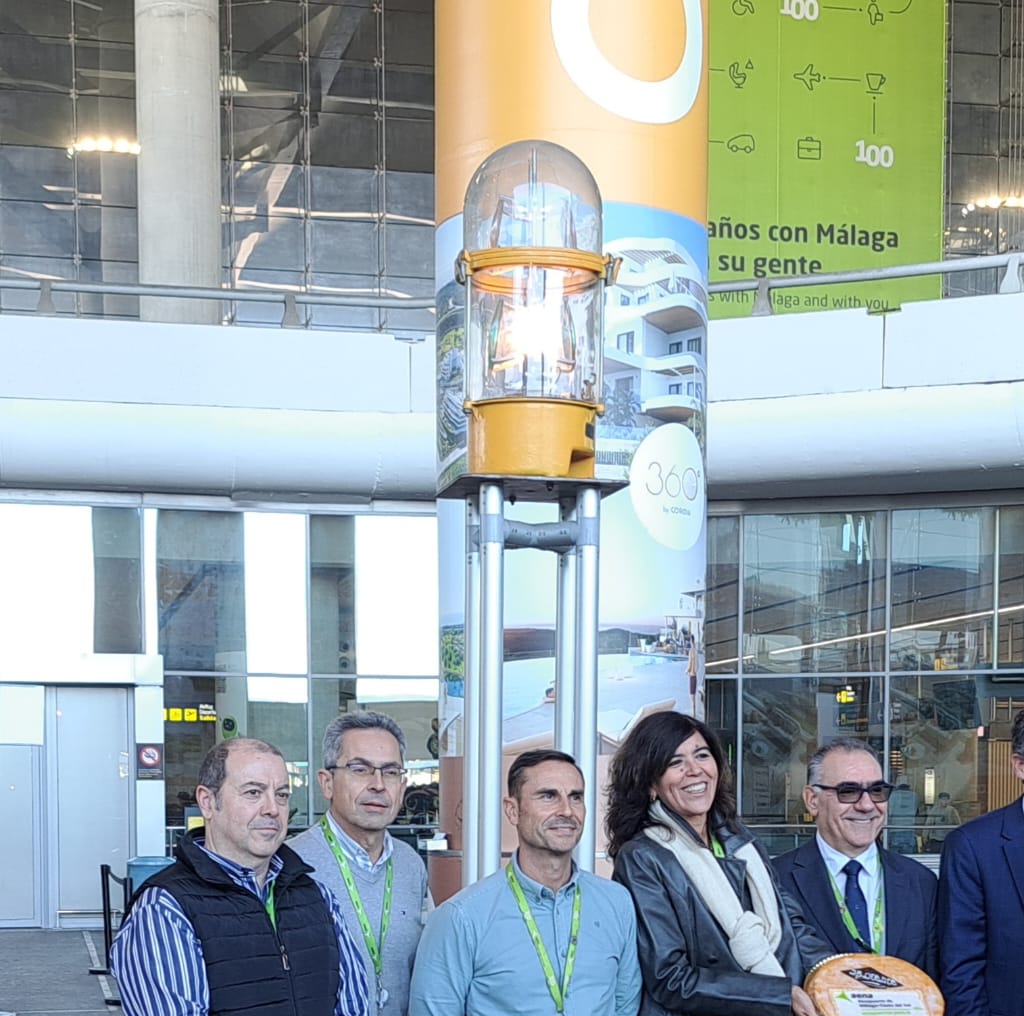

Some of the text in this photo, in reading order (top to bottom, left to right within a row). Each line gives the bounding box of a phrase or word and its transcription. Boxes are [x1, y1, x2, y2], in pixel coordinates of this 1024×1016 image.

[855, 140, 894, 167] 100
[768, 223, 808, 243] con
[816, 223, 899, 252] Málaga
[718, 254, 745, 273] su
[753, 256, 823, 278] gente
[719, 291, 749, 304] with
[804, 294, 828, 308] and
[831, 295, 862, 309] with
